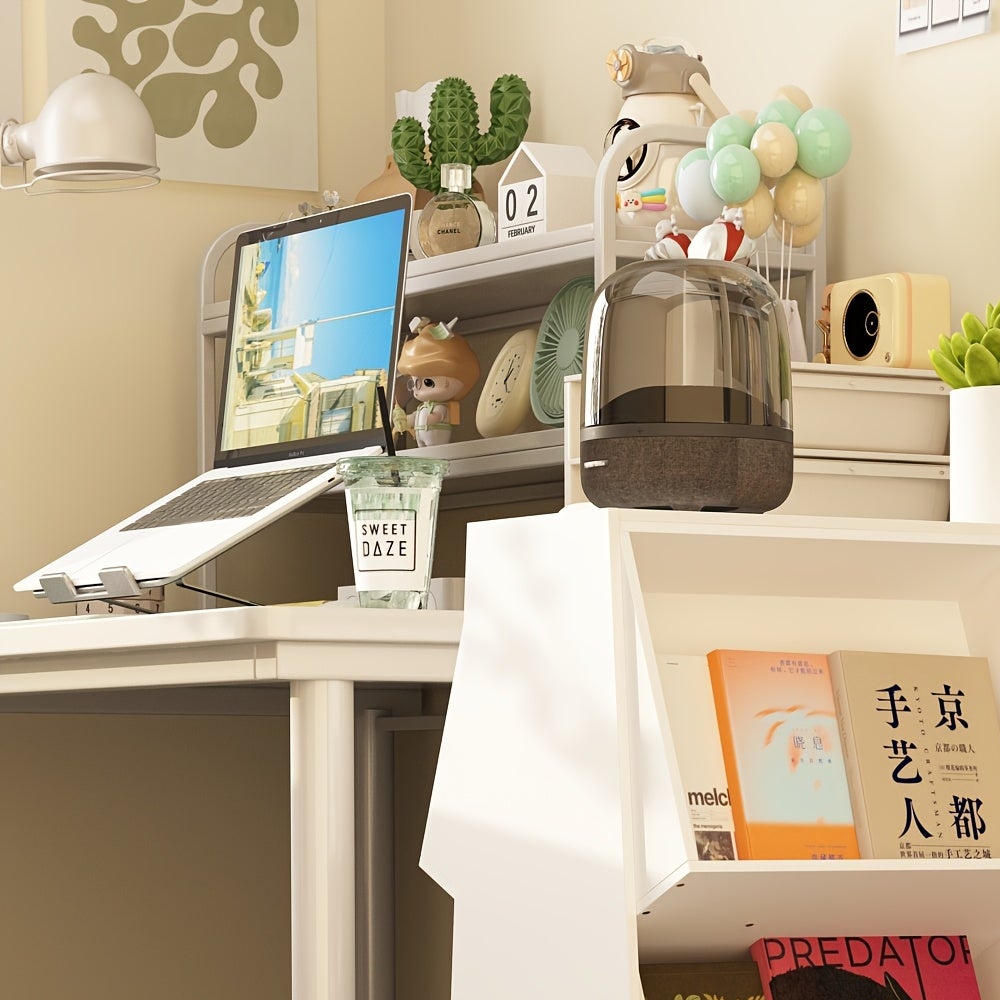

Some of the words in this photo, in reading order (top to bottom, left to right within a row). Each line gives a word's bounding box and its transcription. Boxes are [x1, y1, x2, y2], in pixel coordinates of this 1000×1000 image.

[507, 225, 536, 238] FEBRUARY
[361, 523, 407, 535] SWEET
[875, 684, 933, 839] 手艺人
